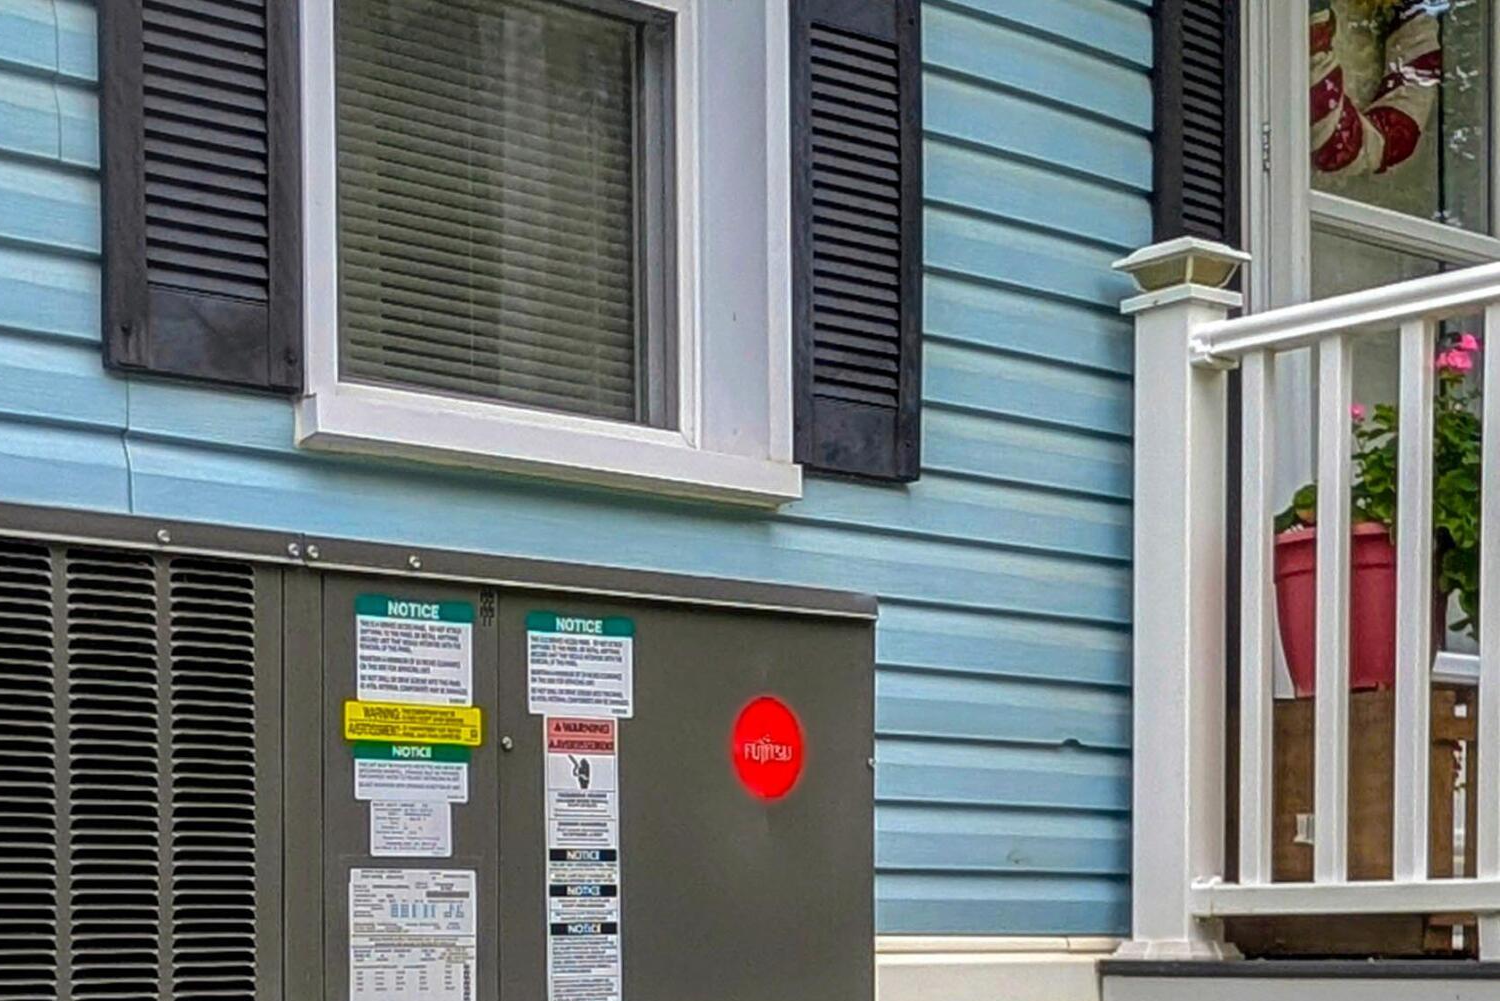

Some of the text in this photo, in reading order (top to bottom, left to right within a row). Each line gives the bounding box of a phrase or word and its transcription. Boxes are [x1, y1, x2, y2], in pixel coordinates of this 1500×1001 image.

[387, 600, 440, 619] NOTICE
[555, 616, 603, 634] NOTICE
[744, 734, 793, 764] FUJITSU
